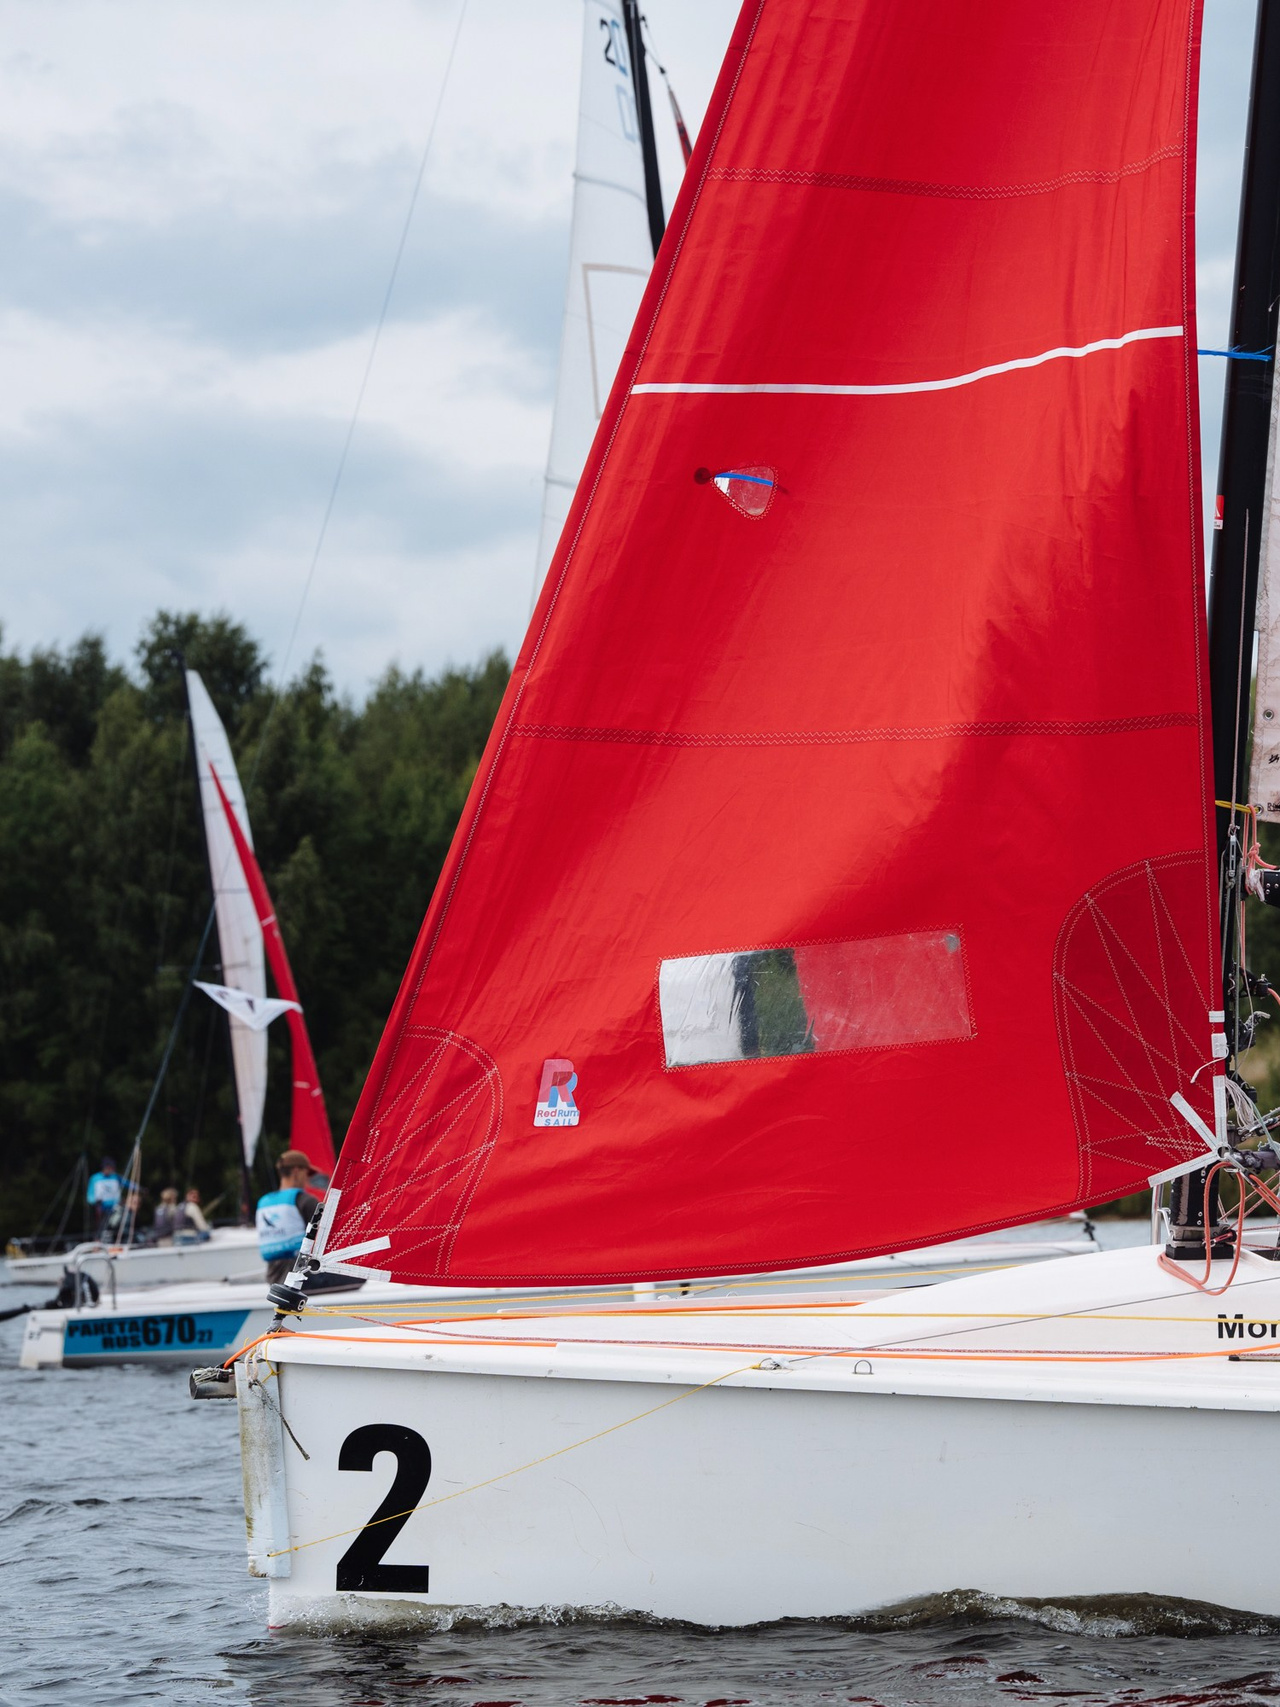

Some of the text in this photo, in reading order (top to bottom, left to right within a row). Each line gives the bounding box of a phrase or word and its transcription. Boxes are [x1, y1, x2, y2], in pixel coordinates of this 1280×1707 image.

[102, 1335, 141, 1349] RUS
[142, 1315, 196, 1346] 670
[336, 1424, 432, 1594] 2
